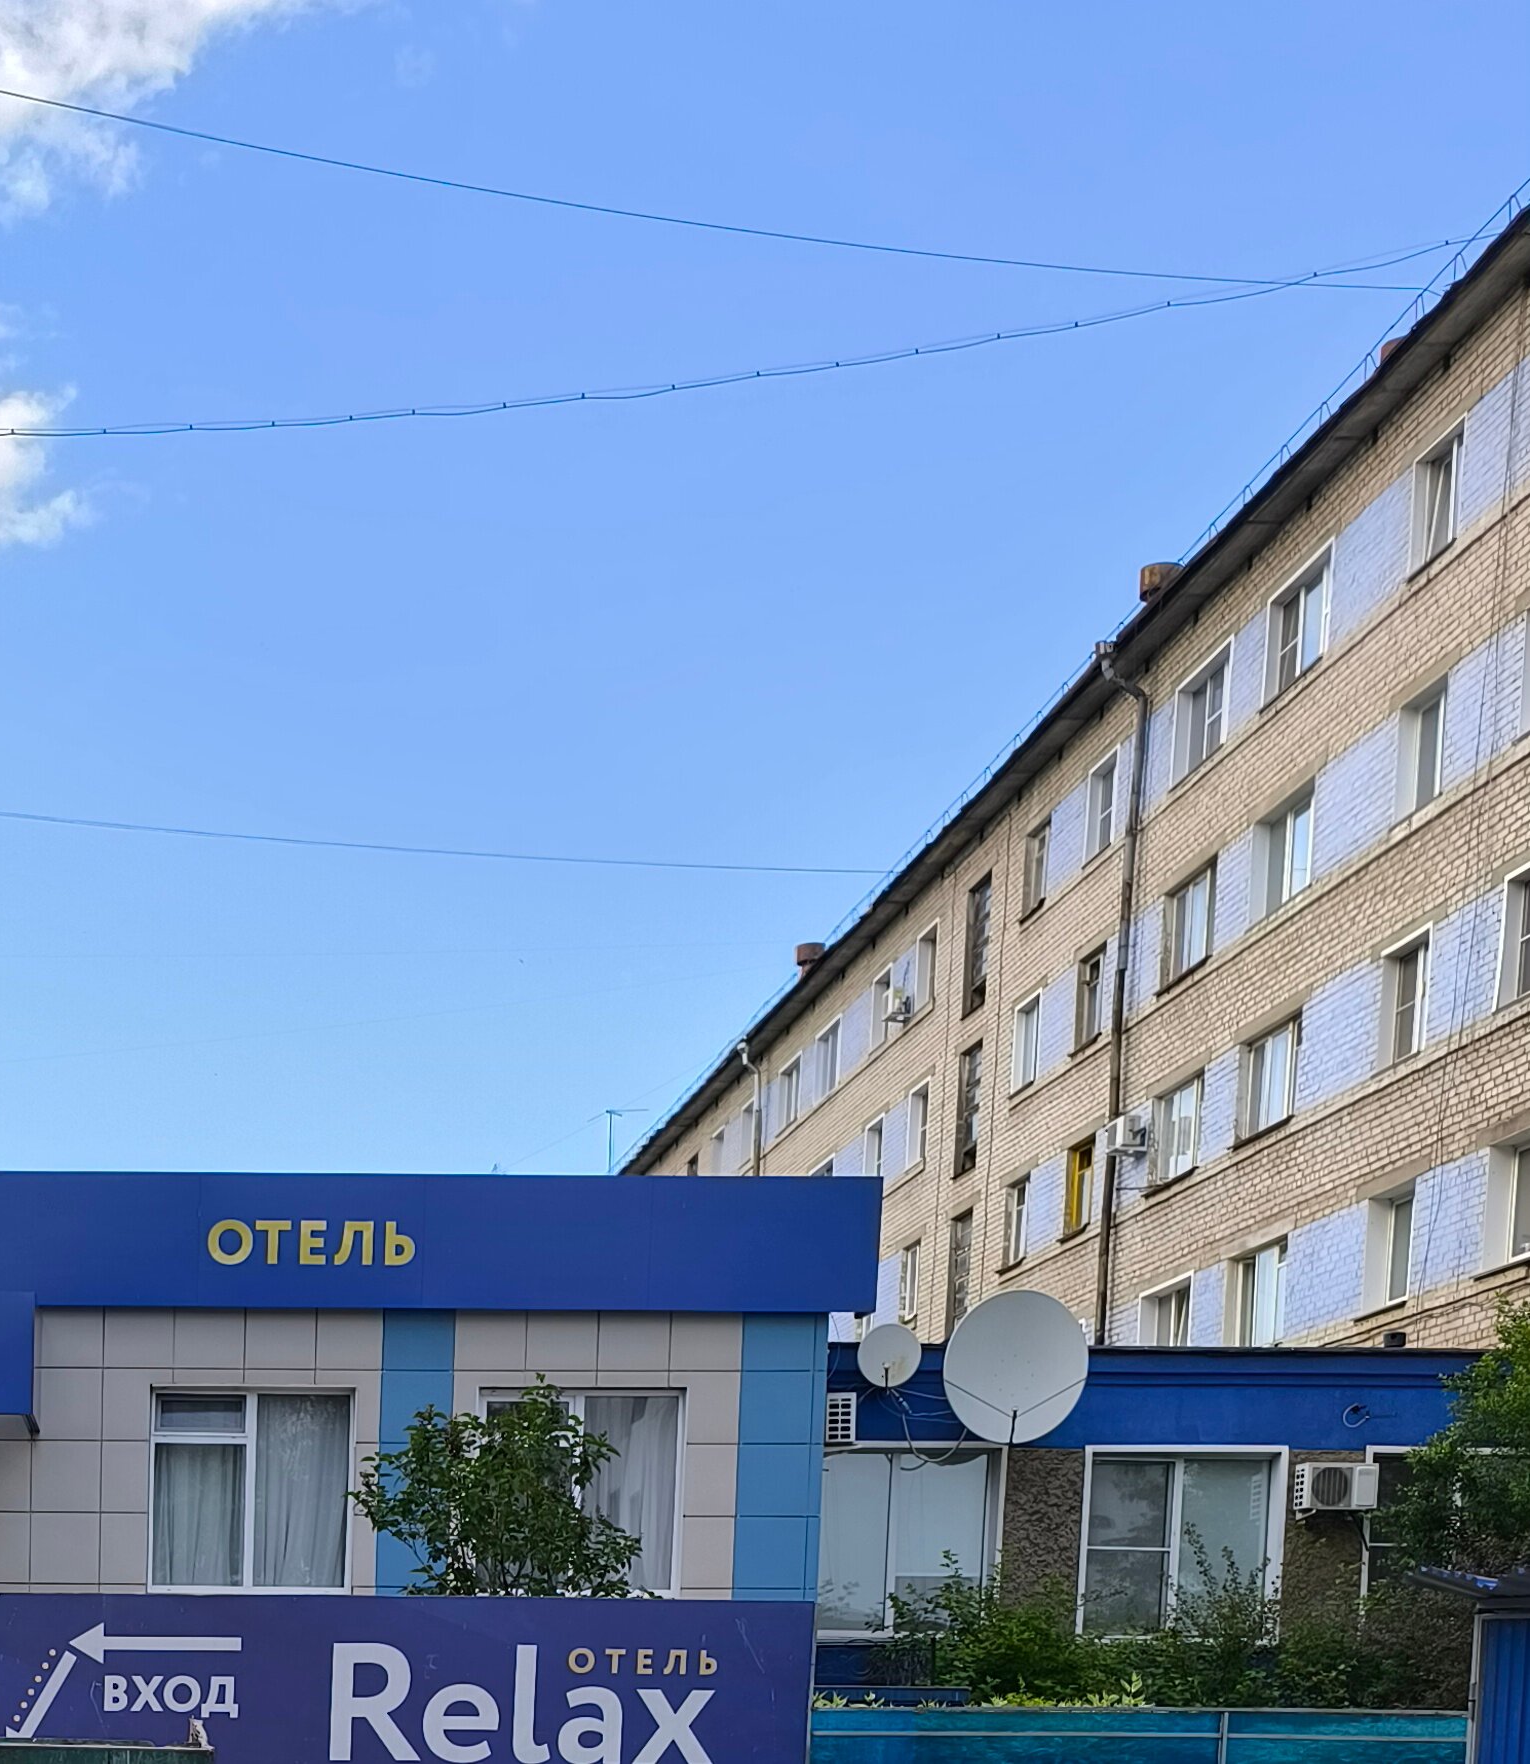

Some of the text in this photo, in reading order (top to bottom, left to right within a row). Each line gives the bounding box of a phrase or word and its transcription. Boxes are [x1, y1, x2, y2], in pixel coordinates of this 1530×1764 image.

[207, 1218, 416, 1266] ОТЕЛЬ
[568, 1647, 718, 1676] ОТЕЛЬ
[103, 1675, 239, 1719] ВХОД
[329, 1642, 716, 1764] Relax
